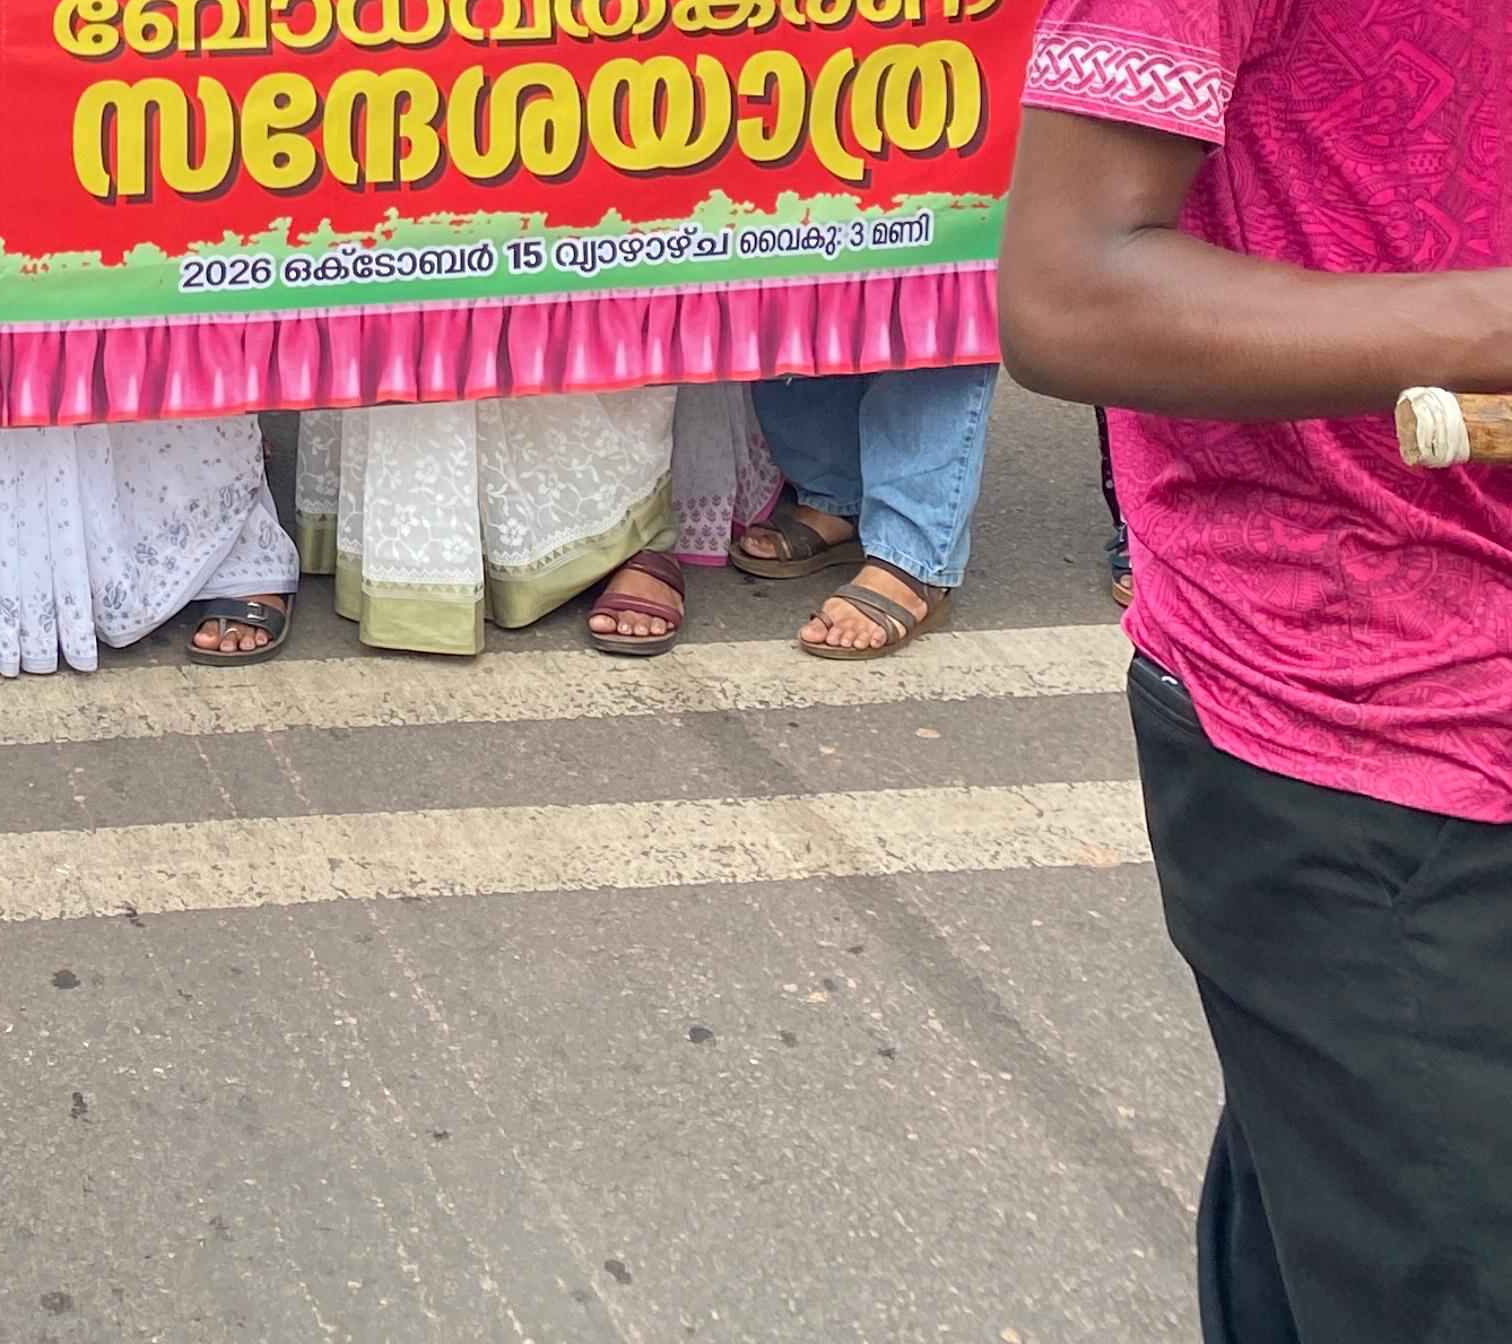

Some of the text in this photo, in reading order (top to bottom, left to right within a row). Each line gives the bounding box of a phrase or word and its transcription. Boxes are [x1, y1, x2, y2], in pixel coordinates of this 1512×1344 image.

[72, 41, 985, 201] സന്ദേശയാത്ര
[182, 257, 272, 288] 2026
[507, 241, 542, 269] 15
[556, 227, 728, 271] വ്യാഴാഴ്ച
[850, 223, 865, 247] 3
[872, 213, 930, 245] മണി
